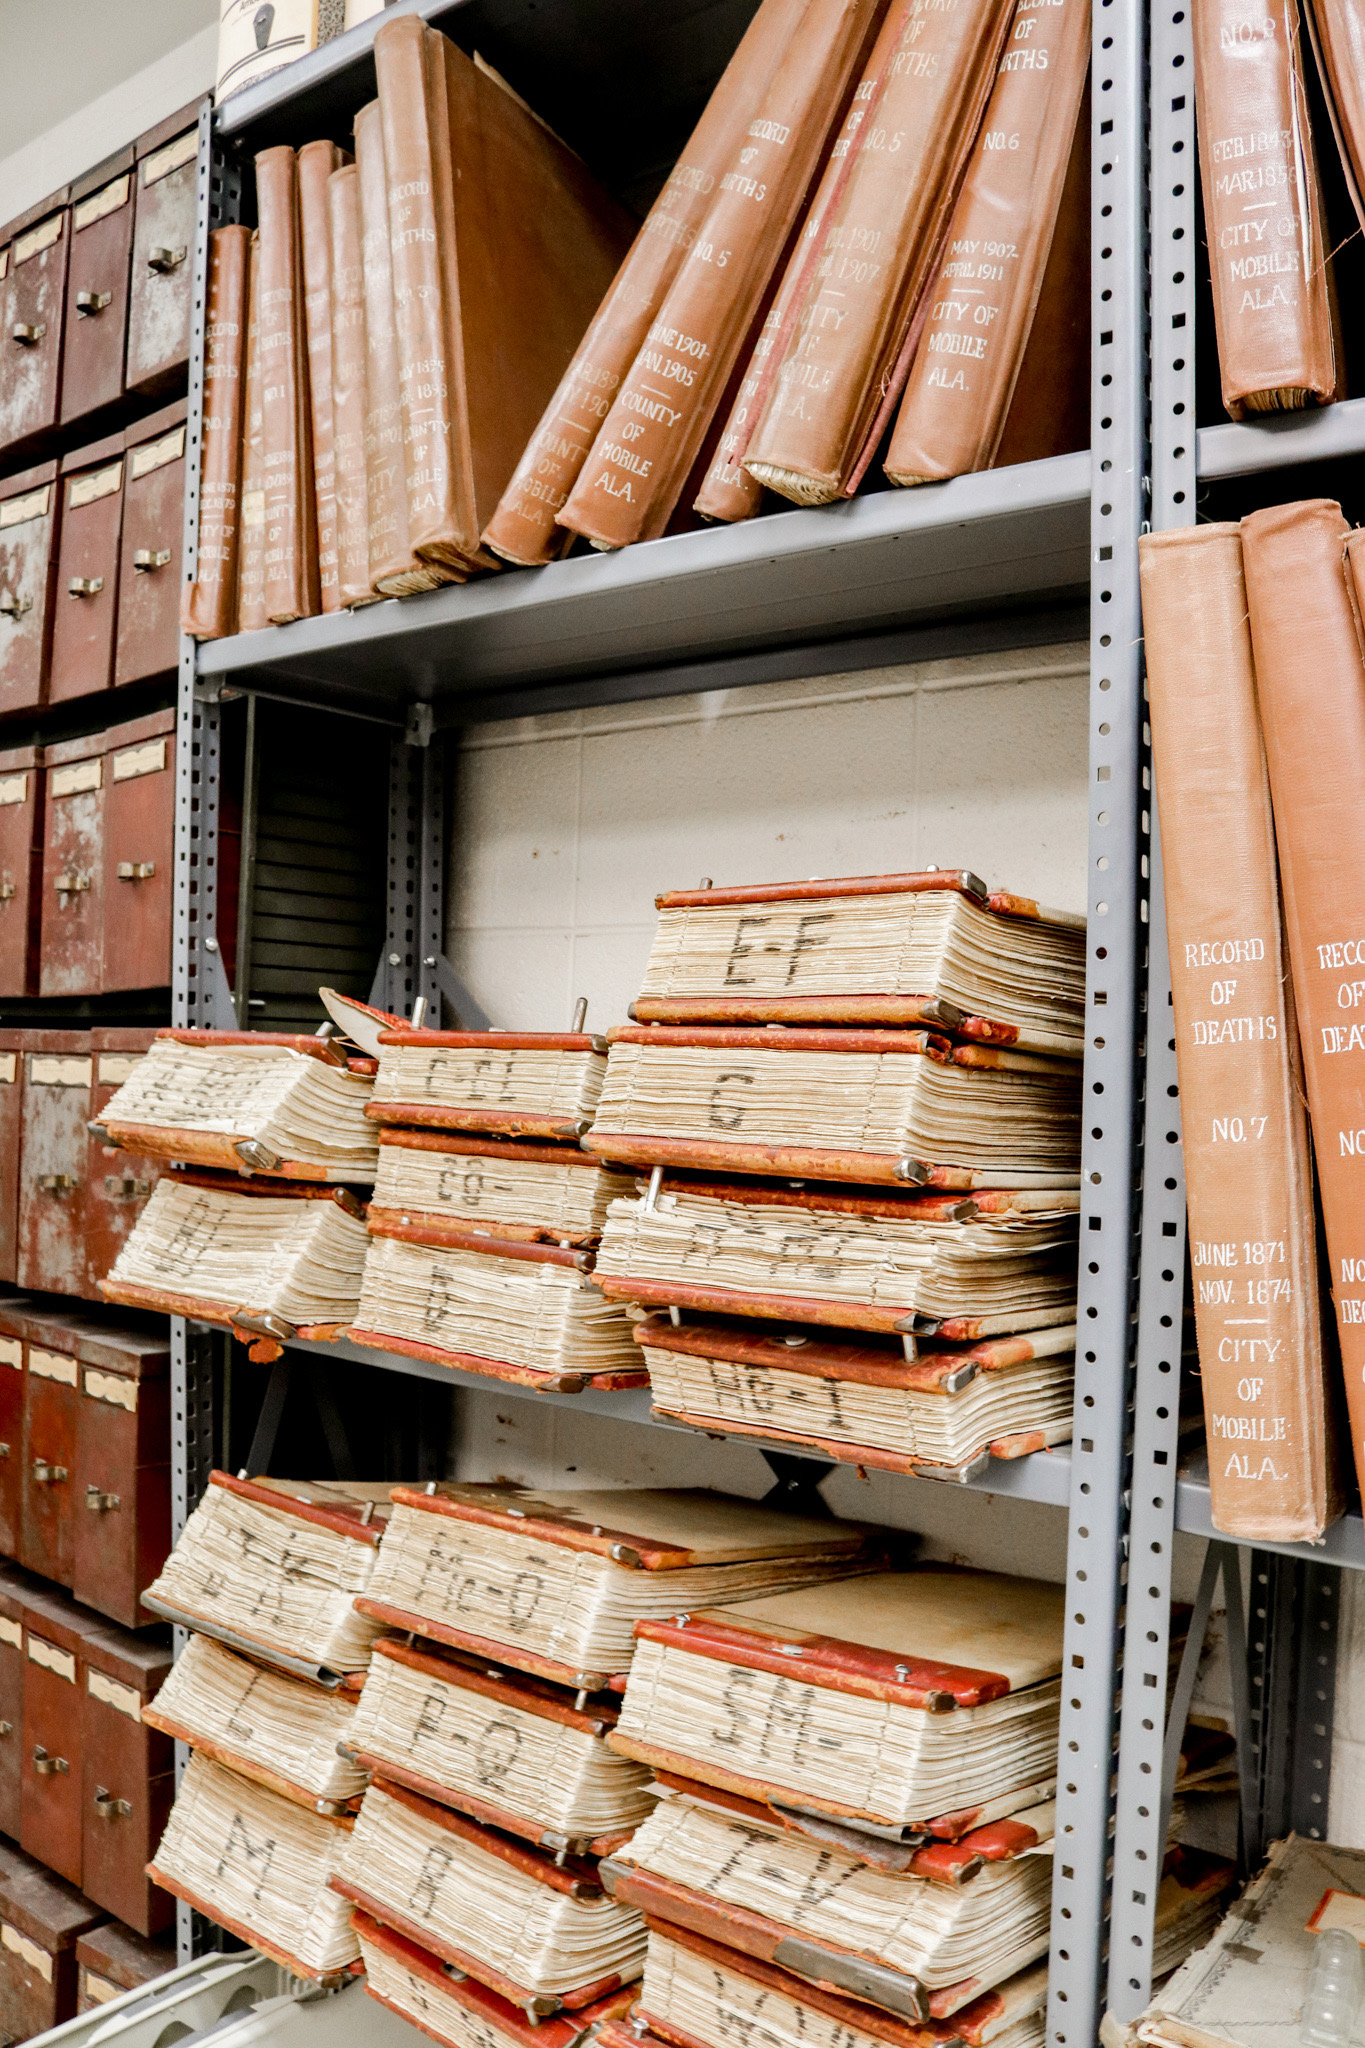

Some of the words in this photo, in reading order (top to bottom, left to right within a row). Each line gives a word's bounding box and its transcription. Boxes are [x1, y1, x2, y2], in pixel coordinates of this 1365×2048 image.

[903, 20, 926, 44] OF
[1014, 18, 1037, 40] OF
[890, 131, 906, 151] 5
[740, 147, 759, 165] OF
[1220, 218, 1270, 249] CITY
[693, 241, 714, 262] NO.
[716, 250, 732, 267] 5
[950, 240, 980, 256] MAY
[942, 262, 976, 279] APRIL
[977, 264, 1004, 281] 1911
[1230, 250, 1300, 282] MOBILE
[932, 301, 970, 321] CITY
[973, 305, 999, 326] OF
[928, 332, 988, 360] MOBILE
[621, 390, 682, 427] COUNTY
[622, 422, 645, 442] OF
[538, 458, 561, 477] OF
[598, 440, 652, 478] MOBILE
[594, 471, 637, 504] ALA.
[1184, 938, 1265, 968] RECORD
[1317, 940, 1365, 969] RECO
[1210, 980, 1237, 1005] OF
[1337, 981, 1365, 1009] OF
[1192, 1015, 1277, 1045] DEATHS
[1250, 1116, 1268, 1139] 7
[1194, 1241, 1238, 1267] JUNE
[1243, 1240, 1286, 1266] 1871
[1199, 1280, 1236, 1304] NOV.
[1247, 1278, 1292, 1304] 1874
[1218, 1337, 1282, 1363] CITY
[1238, 1378, 1264, 1402] OF
[1212, 1414, 1286, 1442] MOBILE
